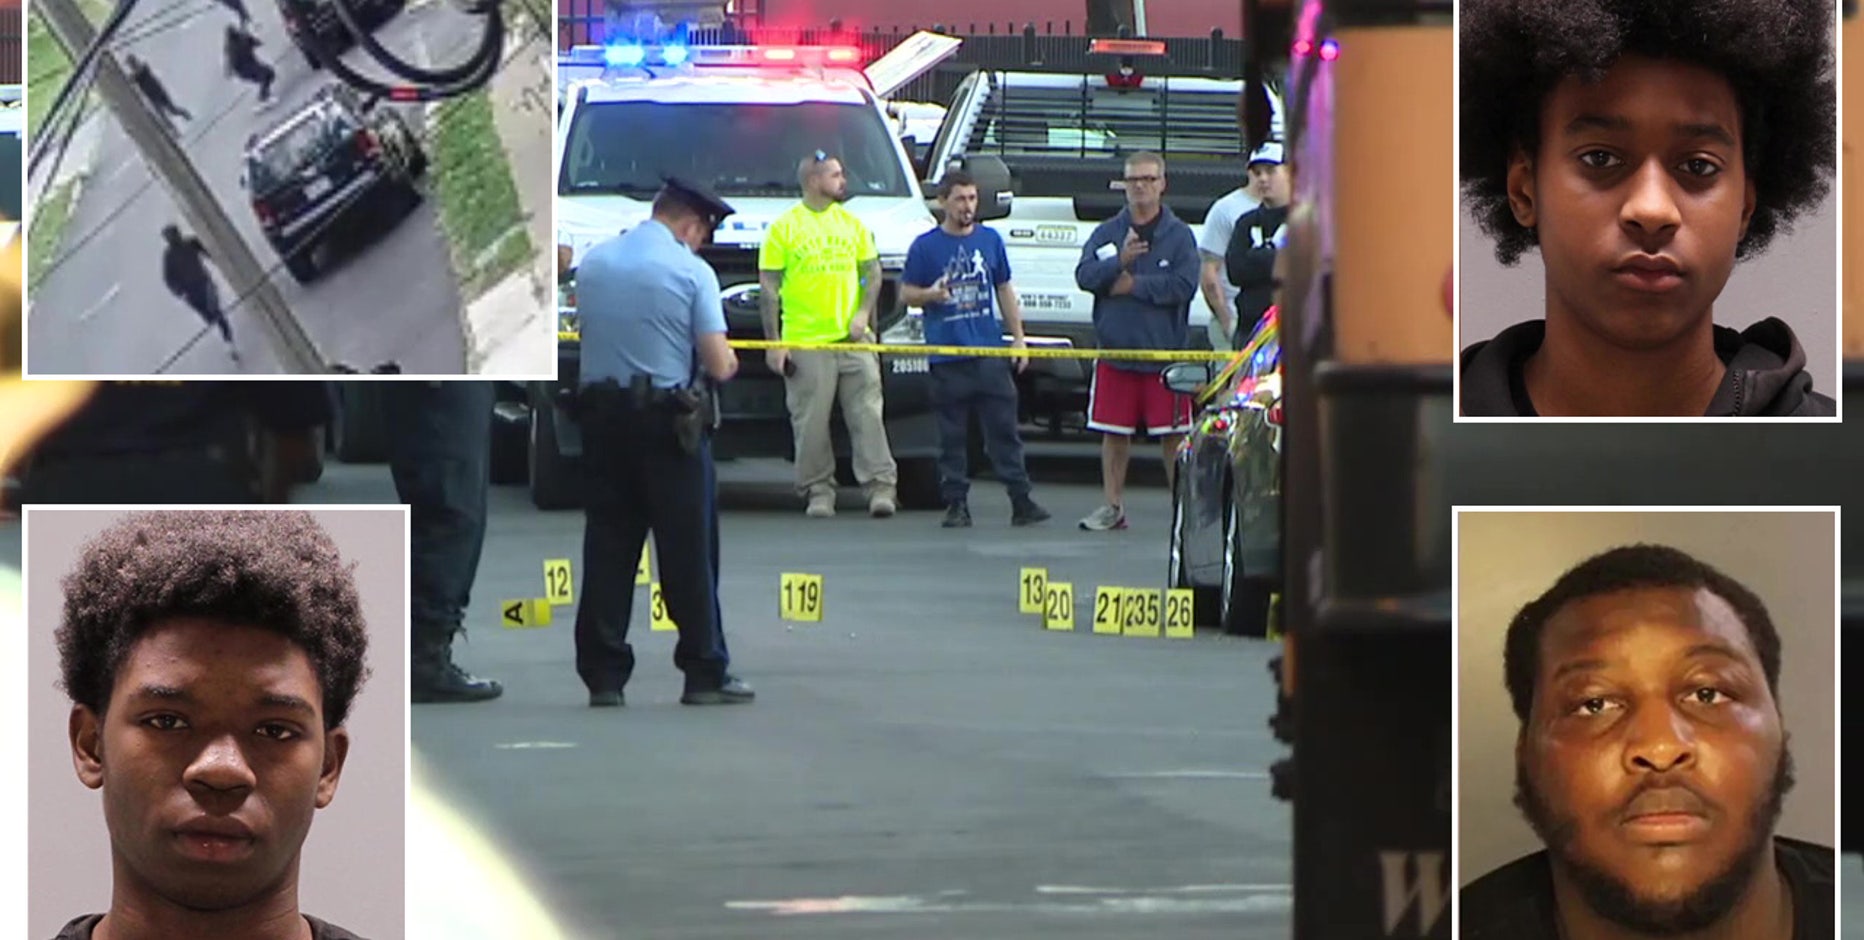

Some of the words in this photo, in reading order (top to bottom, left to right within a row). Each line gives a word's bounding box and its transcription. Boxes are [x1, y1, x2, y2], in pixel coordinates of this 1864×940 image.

[547, 566, 568, 597] 12
[1023, 574, 1043, 605] 13
[504, 601, 524, 625] A
[1043, 589, 1070, 621] 20
[1097, 592, 1121, 624] 21
[1168, 596, 1190, 627] 26
